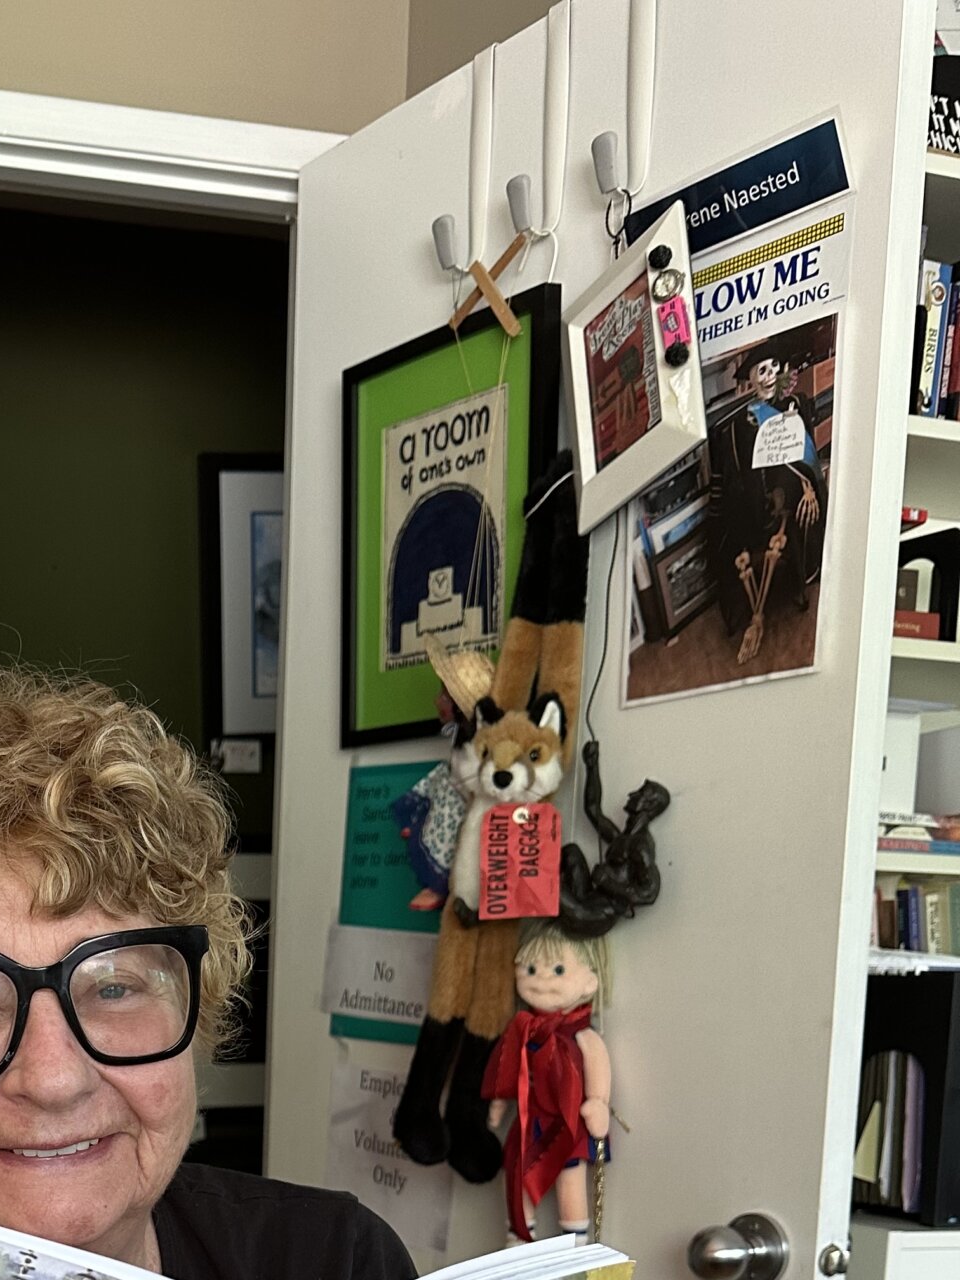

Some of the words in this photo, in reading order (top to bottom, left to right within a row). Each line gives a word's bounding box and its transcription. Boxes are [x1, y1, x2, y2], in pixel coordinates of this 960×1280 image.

[722, 160, 801, 214] Naested
[695, 267, 765, 321] LOW
[772, 245, 822, 292] ME
[747, 304, 770, 327] I'M
[773, 282, 830, 316] GOING
[924, 327, 938, 374] BIRDS
[399, 432, 416, 465] a
[421, 405, 490, 457] room
[401, 465, 413, 496] of
[455, 448, 486, 471] own
[486, 813, 509, 915] OVERWEIGHT
[373, 960, 395, 983] No
[339, 988, 425, 1019] Admittance
[372, 1164, 408, 1195] Only
